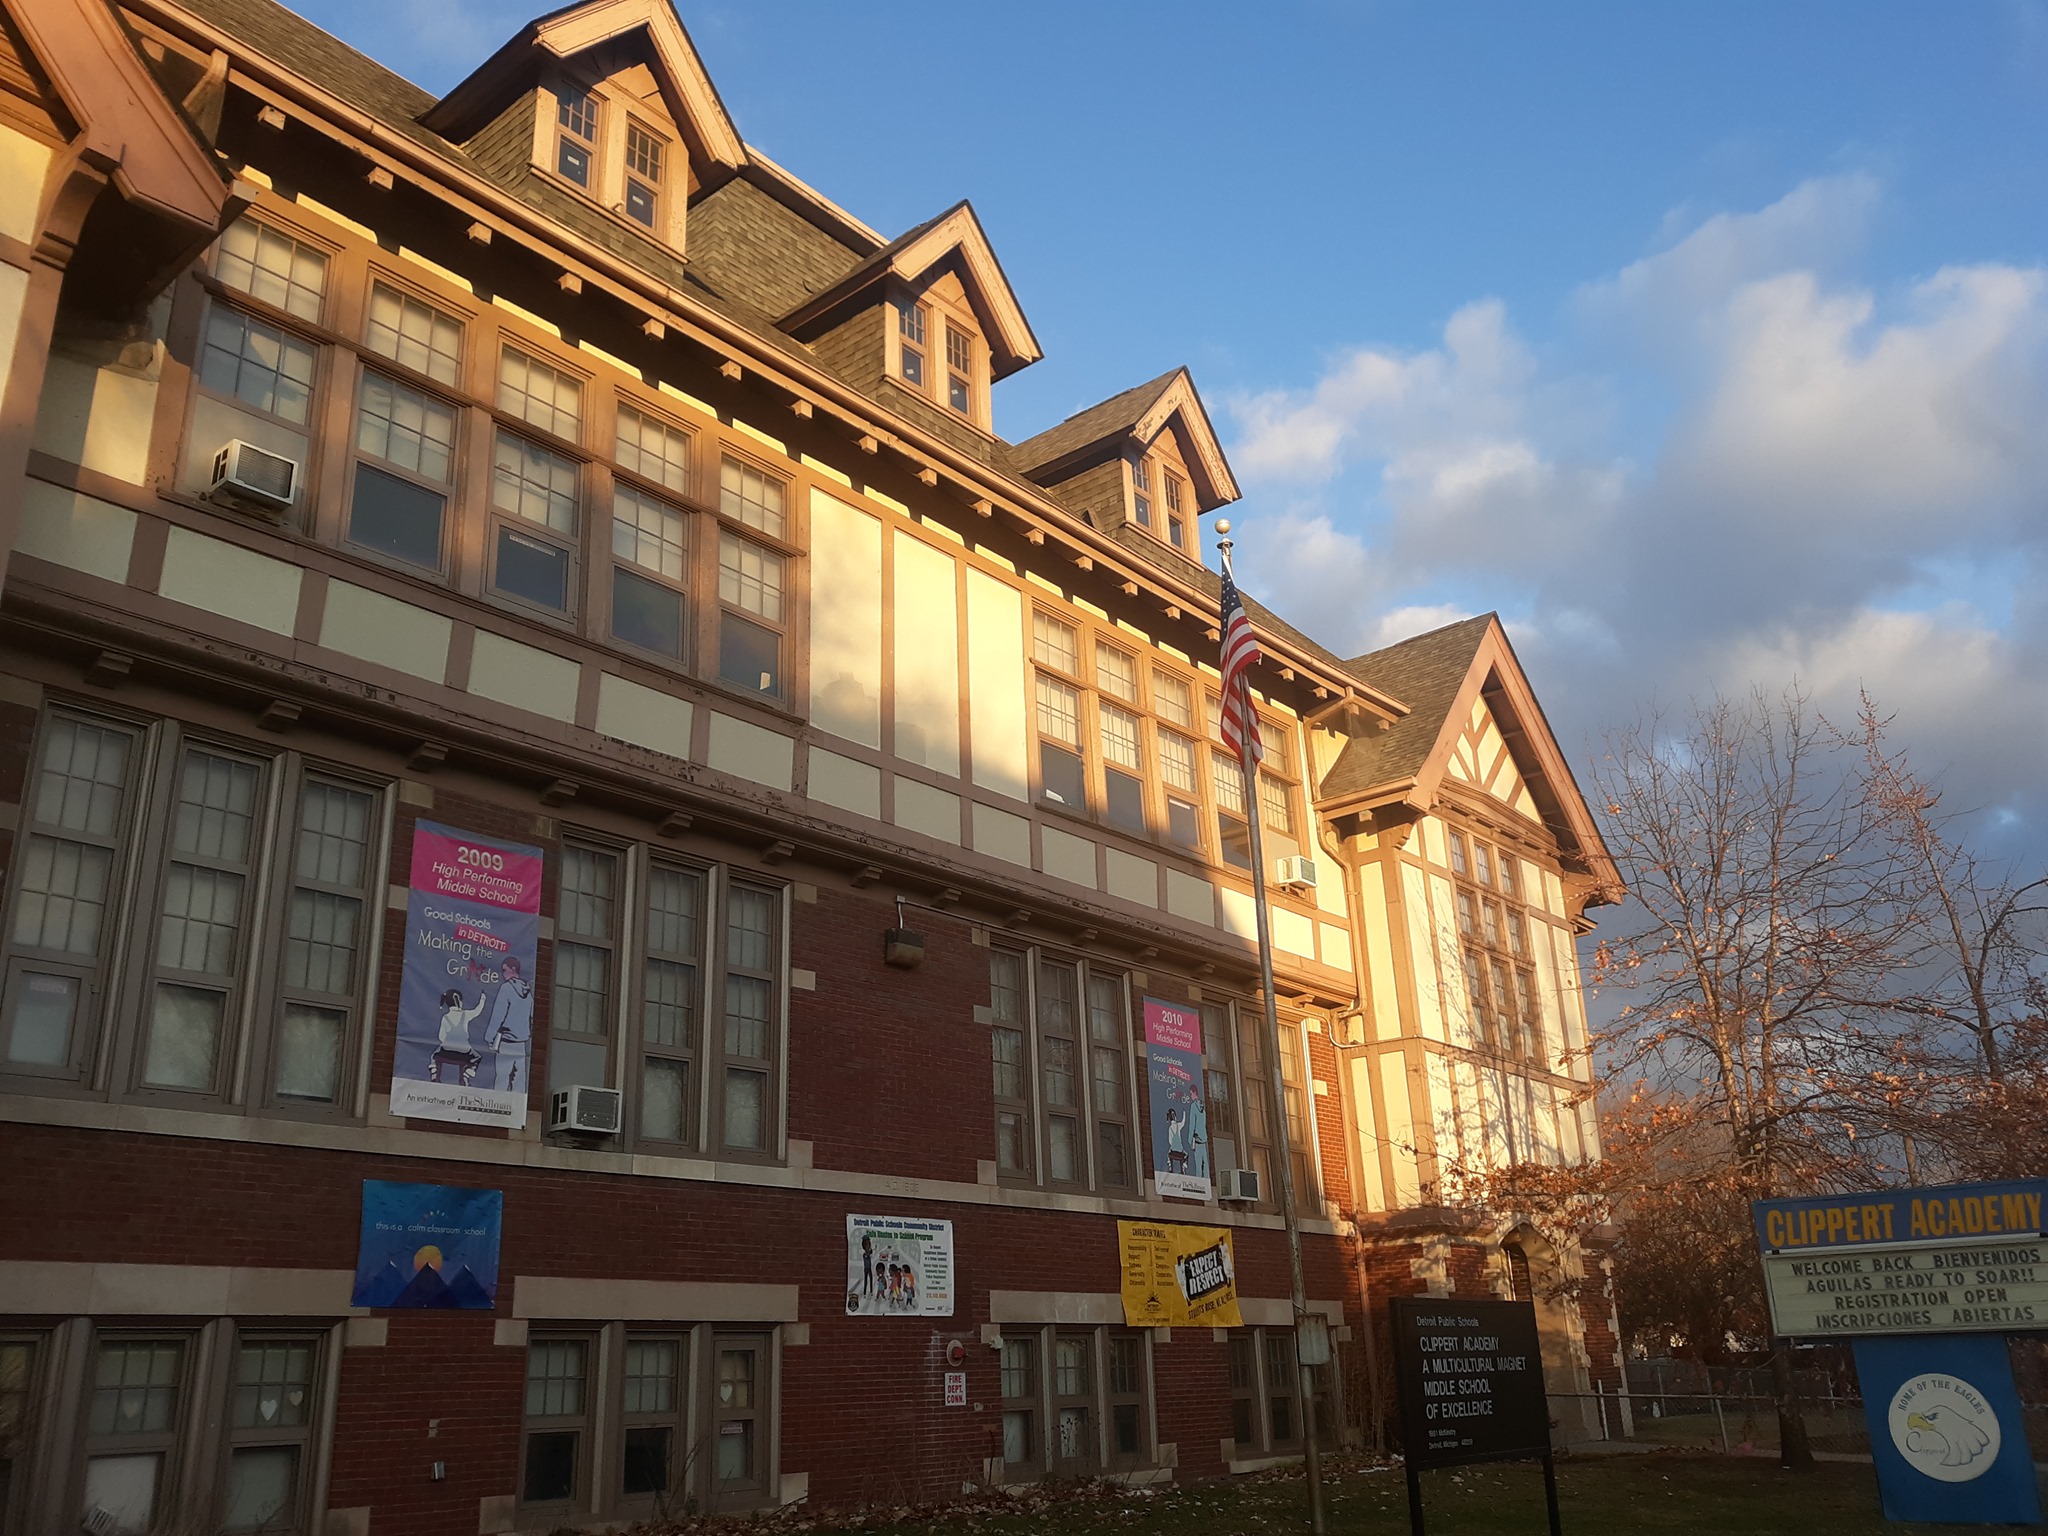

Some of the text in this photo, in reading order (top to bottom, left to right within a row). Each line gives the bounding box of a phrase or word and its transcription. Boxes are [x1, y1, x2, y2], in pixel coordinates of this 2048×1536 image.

[458, 846, 503, 871] 2009
[432, 862, 523, 894] High Performing
[437, 878, 517, 905] Middle School
[424, 906, 491, 930] Good Schools
[458, 927, 467, 937] in
[417, 929, 493, 960] Making the
[1162, 1010, 1183, 1026] 2010
[1153, 1022, 1193, 1040] High Performing
[1156, 1033, 1191, 1048] Middle School
[1153, 1053, 1183, 1067] Good Schools
[1153, 1070, 1176, 1088] Making
[417, 1095, 446, 1106] initiative
[447, 1098, 456, 1106] of
[376, 1222, 389, 1230] this
[390, 1223, 396, 1231] is
[408, 1224, 426, 1232] calm
[427, 1224, 460, 1234] classroom
[464, 1228, 486, 1236] school
[870, 1219, 884, 1228] Public
[885, 1220, 902, 1229] Schools
[904, 1221, 928, 1231] Community
[929, 1222, 944, 1231] District
[1766, 1192, 2042, 1248] CLIPPERT ACADEMY
[900, 1232, 914, 1240] School
[915, 1233, 933, 1241] Program
[1189, 1251, 1219, 1277] EXPECT
[1791, 1248, 2041, 1276] WELCOME BACK BIENVENIDOS
[1189, 1266, 1224, 1295] RESPECT
[1807, 1268, 2035, 1293] AGUILAS READY TO SOAR!!
[1835, 1288, 2008, 1310] REGISTRATION OPEN
[1417, 1316, 1479, 1327] Detroit Public Schools
[1816, 1306, 2035, 1328] INSCRIPCIONES ABIERTAS
[1420, 1337, 1499, 1352] CLIPPERT ACADEMY
[1422, 1356, 1526, 1374] A MULTICULTURAL MAGNET
[949, 1375, 962, 1383] FIRE
[1424, 1379, 1492, 1396] MIDDLE SCHOOL
[948, 1385, 963, 1393] DEPT.
[1898, 1380, 1986, 1415] HOME OF THE EAGLES
[947, 1395, 964, 1403] CONN.
[1426, 1400, 1494, 1420] OF EXCELLENCE
